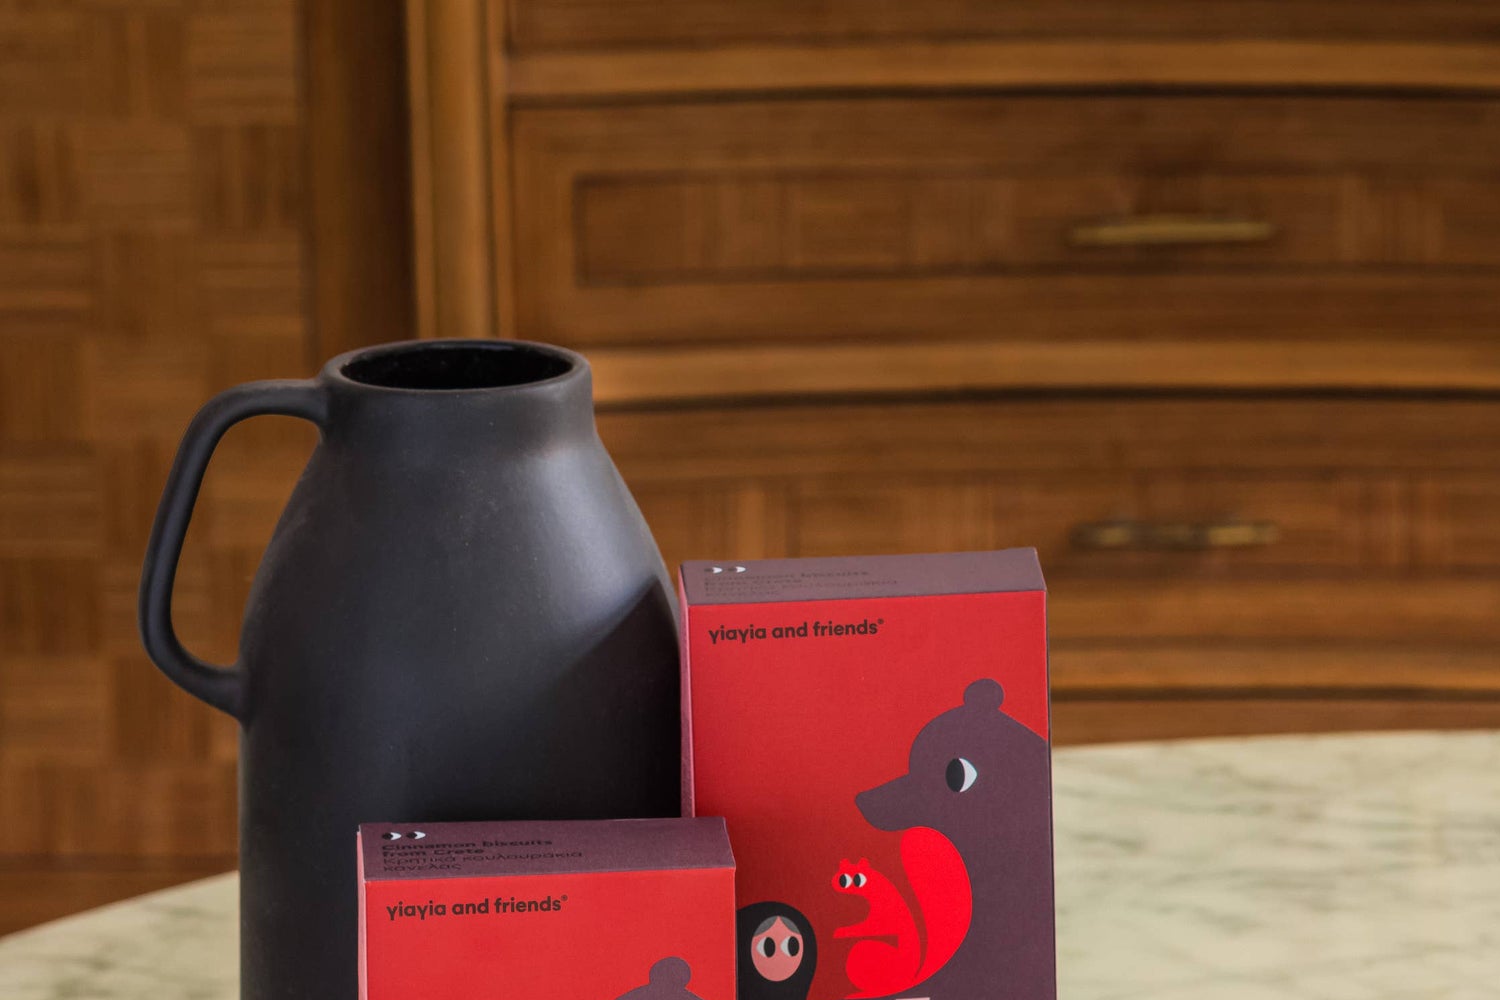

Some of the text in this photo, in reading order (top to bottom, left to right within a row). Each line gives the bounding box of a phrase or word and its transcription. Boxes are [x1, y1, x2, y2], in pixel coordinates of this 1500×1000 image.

[708, 624, 767, 645] yiayia
[771, 621, 808, 639] and
[381, 841, 477, 851] Cinnamon
[386, 900, 447, 921] yiayia
[451, 898, 490, 916] and
